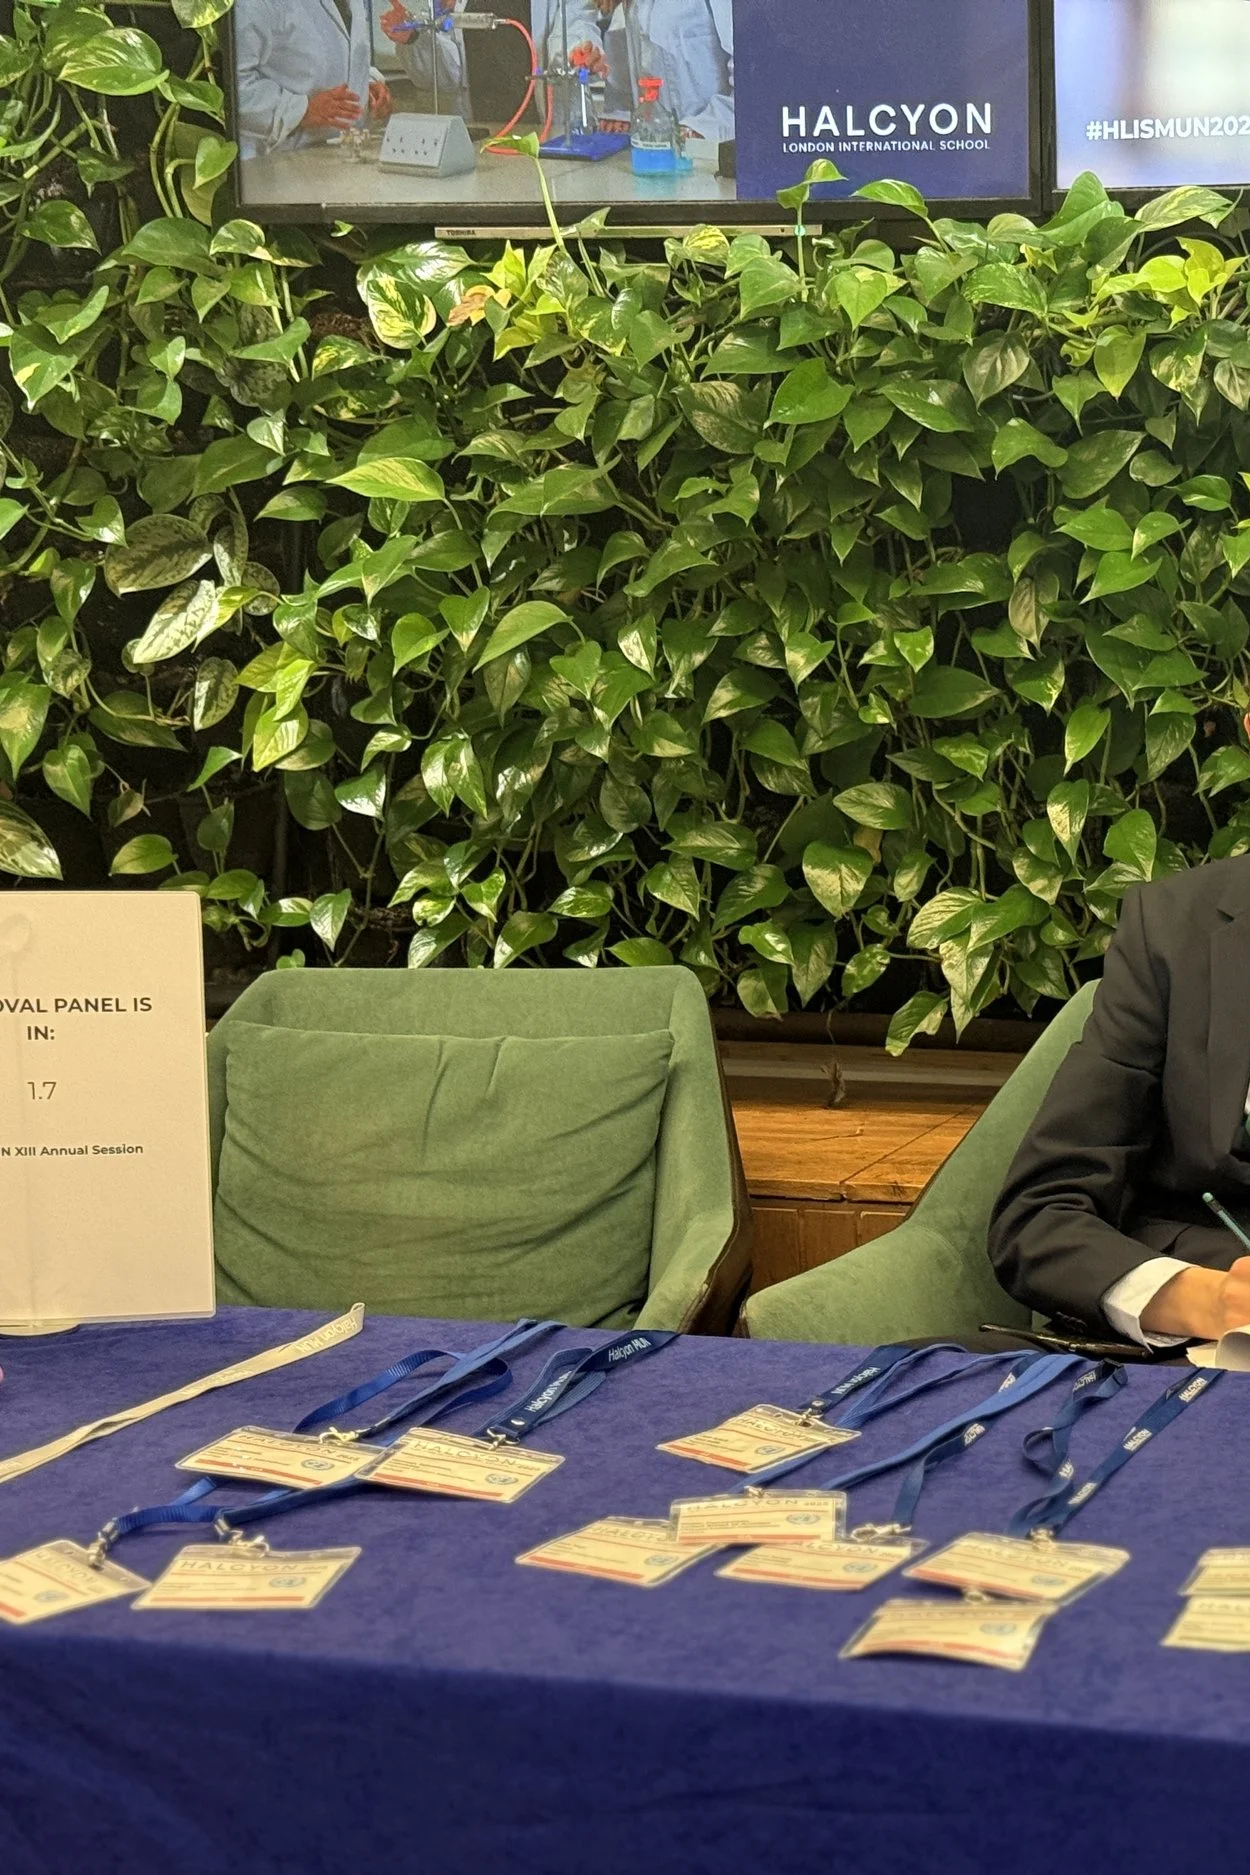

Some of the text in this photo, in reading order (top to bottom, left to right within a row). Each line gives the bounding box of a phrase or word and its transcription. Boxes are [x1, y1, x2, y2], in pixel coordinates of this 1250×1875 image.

[782, 103, 991, 137] HALCYON
[783, 138, 990, 153] LONDON INTERNATIONAL SCHOOL
[54, 997, 128, 1013] PANEL
[133, 997, 153, 1012] IS
[27, 1026, 55, 1040] IN:
[27, 1081, 57, 1100] 1.7
[15, 1146, 37, 1156] XIII
[40, 1145, 89, 1156] Annual
[92, 1144, 144, 1156] Session
[608, 1345, 633, 1362] Halcyon
[524, 1383, 556, 1412] Halcyon
[413, 1440, 517, 1466] HALCYON
[180, 1560, 298, 1572] HALCYON
